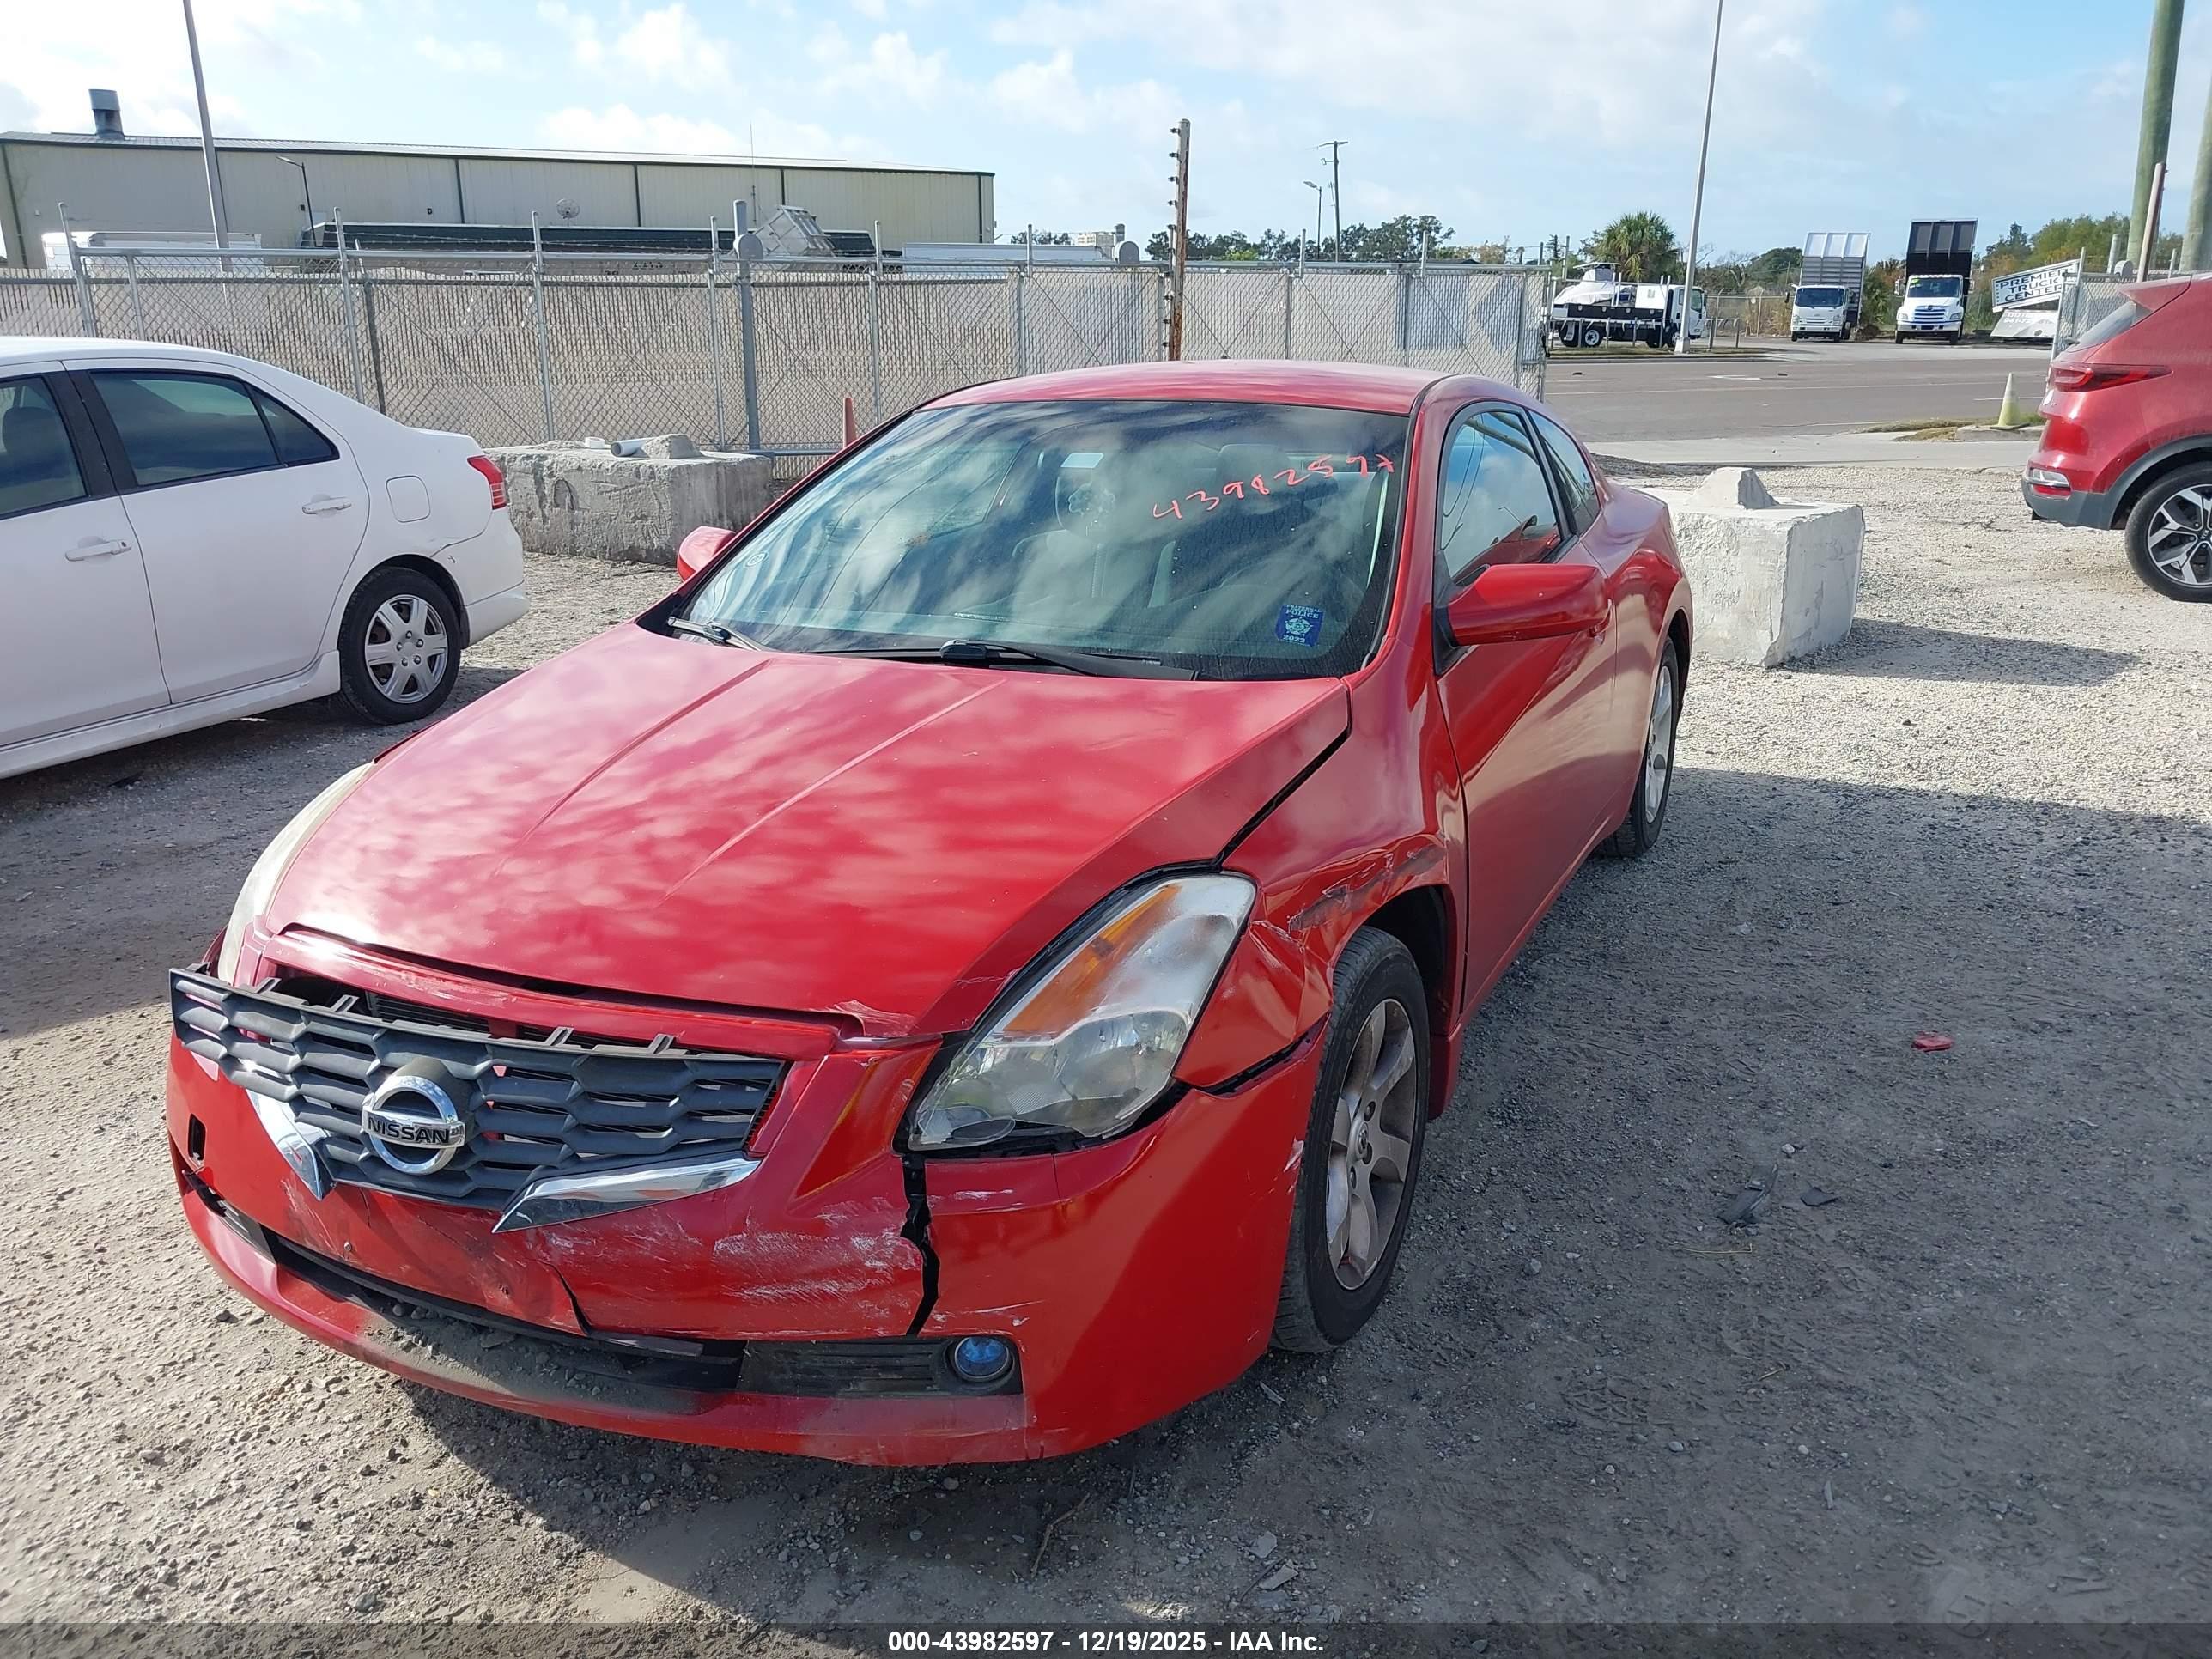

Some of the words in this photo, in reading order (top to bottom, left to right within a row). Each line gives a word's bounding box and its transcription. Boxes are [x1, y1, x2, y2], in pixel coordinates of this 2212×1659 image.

[2009, 277, 2059, 293] TRUCK
[1285, 609, 1319, 619] POLICE
[368, 1116, 450, 1144] NISSAN
